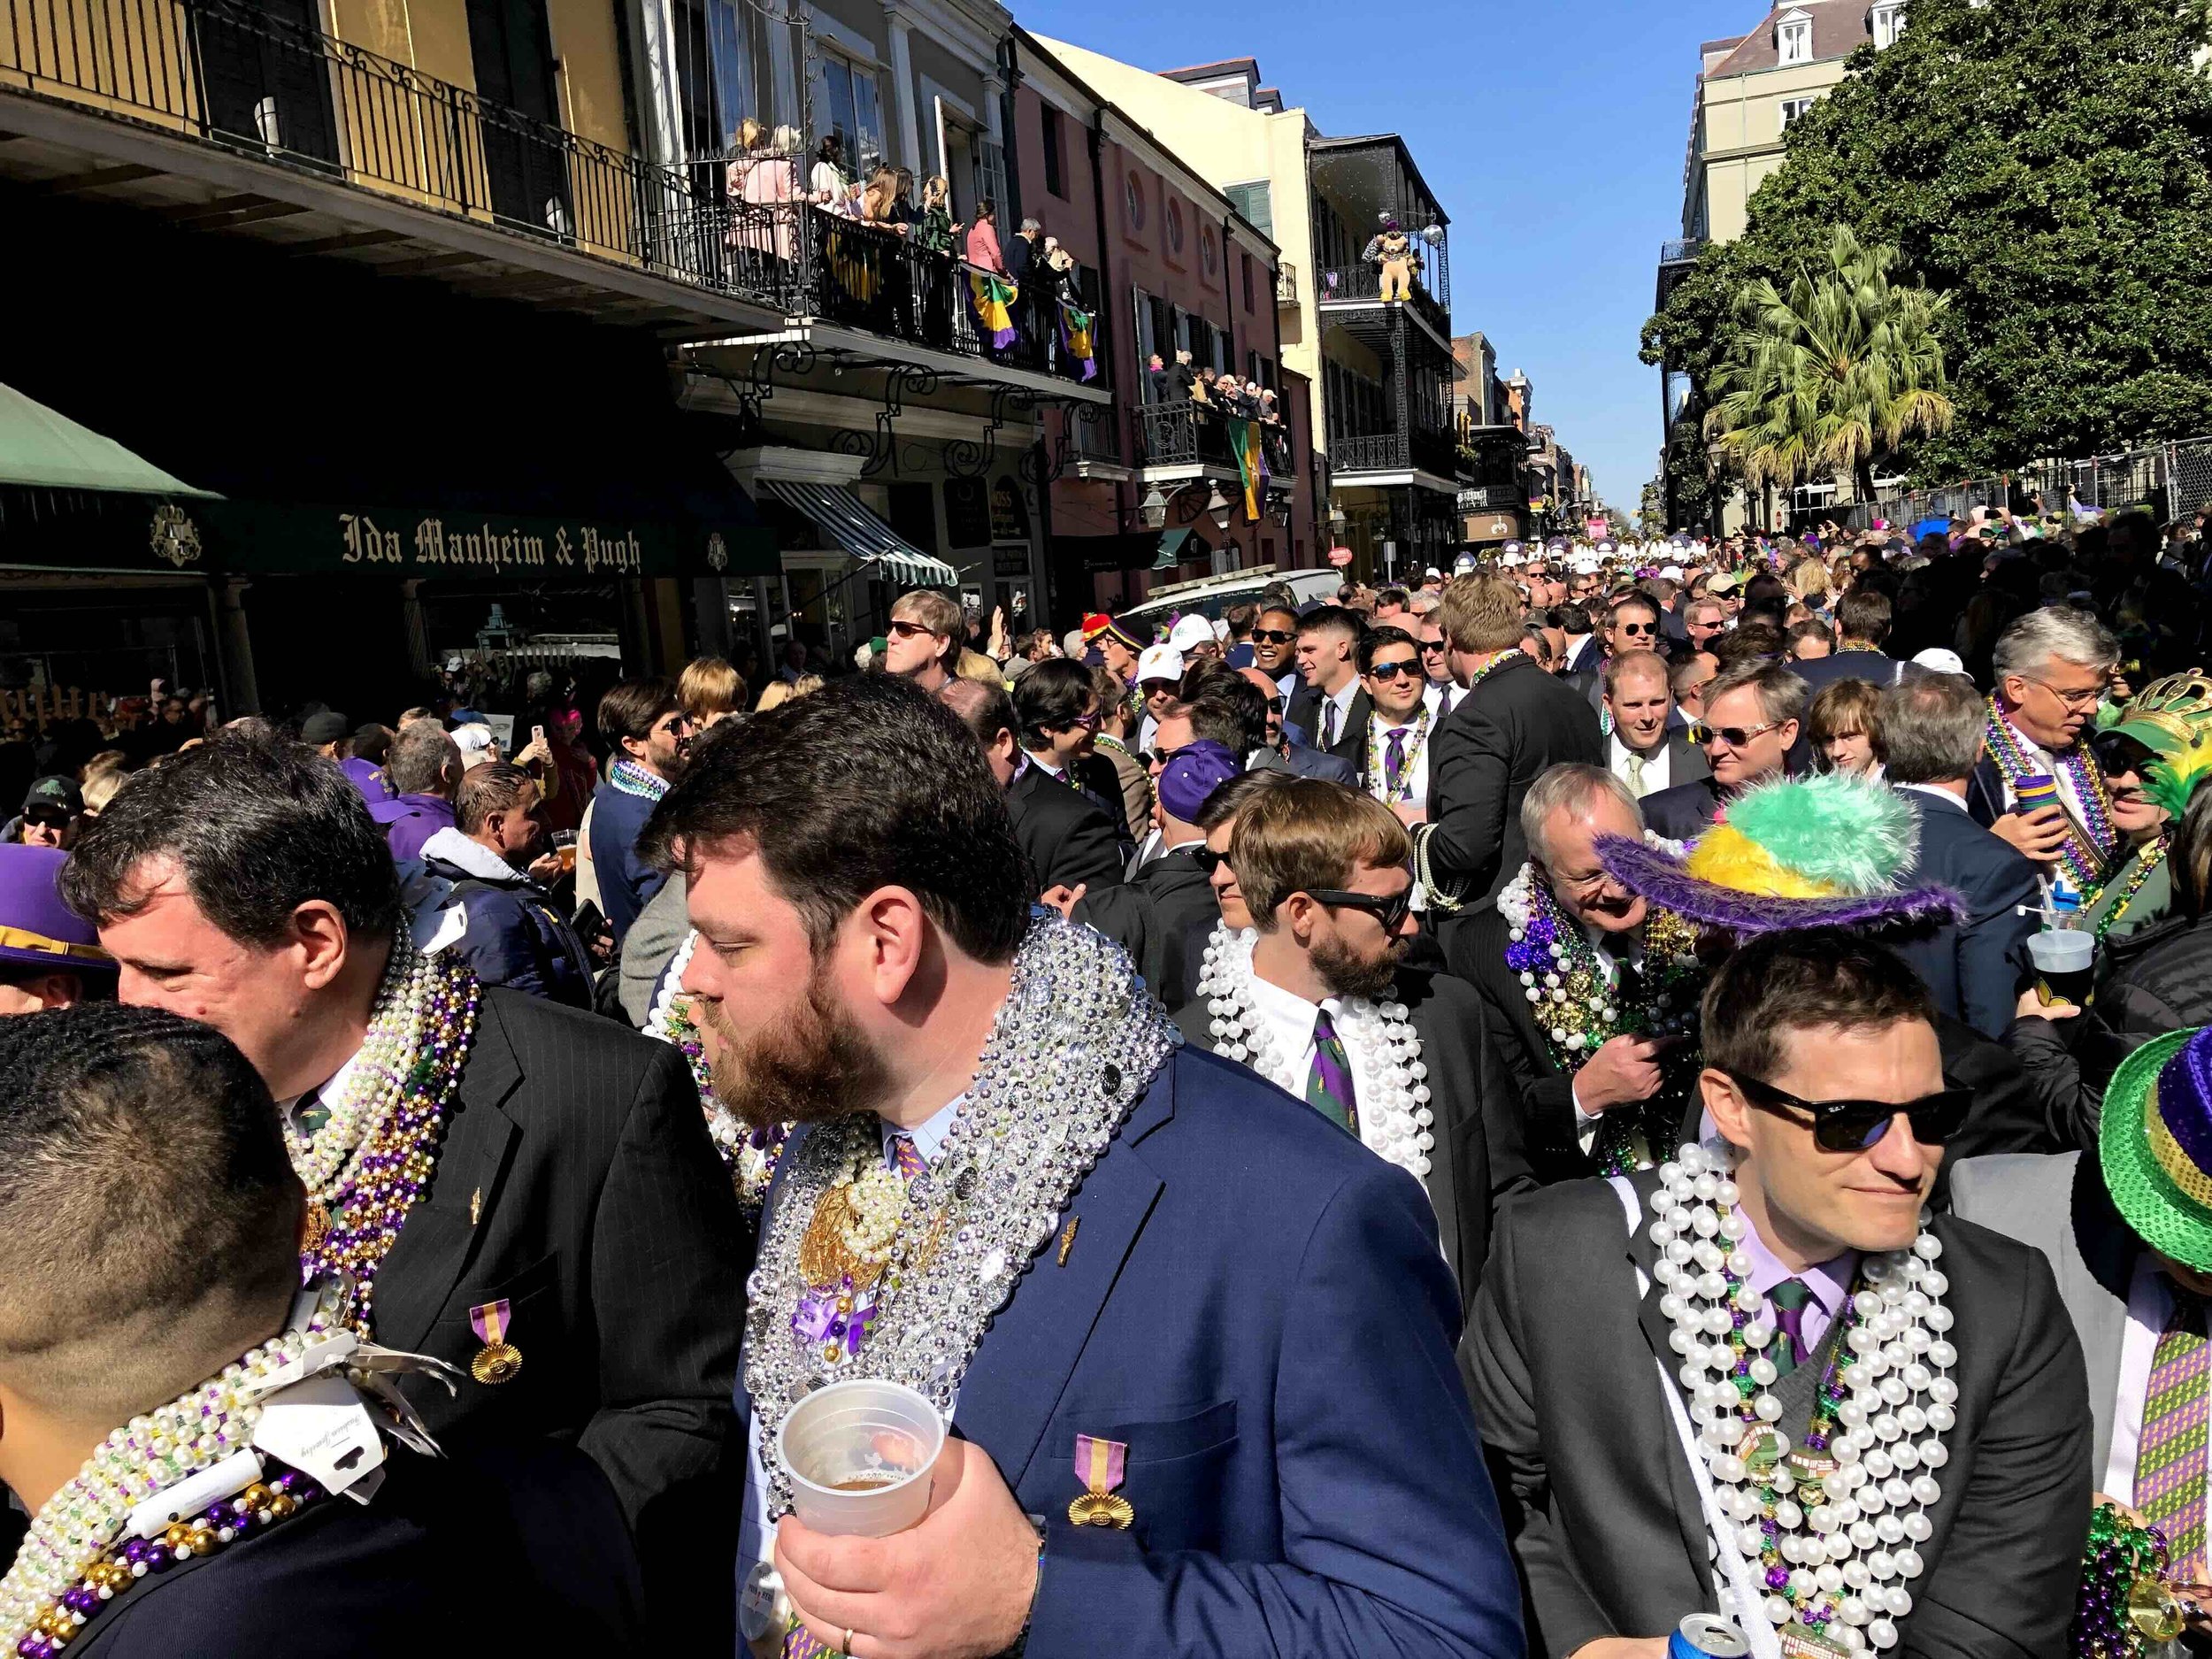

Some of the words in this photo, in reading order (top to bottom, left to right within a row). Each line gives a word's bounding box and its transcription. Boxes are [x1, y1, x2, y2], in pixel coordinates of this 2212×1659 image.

[338, 513, 403, 564] Ida
[414, 517, 545, 574] Manheim
[555, 526, 575, 566] &
[580, 526, 641, 574] Pugh
[1141, 607, 1164, 617] NEW
[1217, 589, 1254, 598] POLICE
[331, 1415, 361, 1436] Fashion
[300, 1431, 331, 1458] Jewelry
